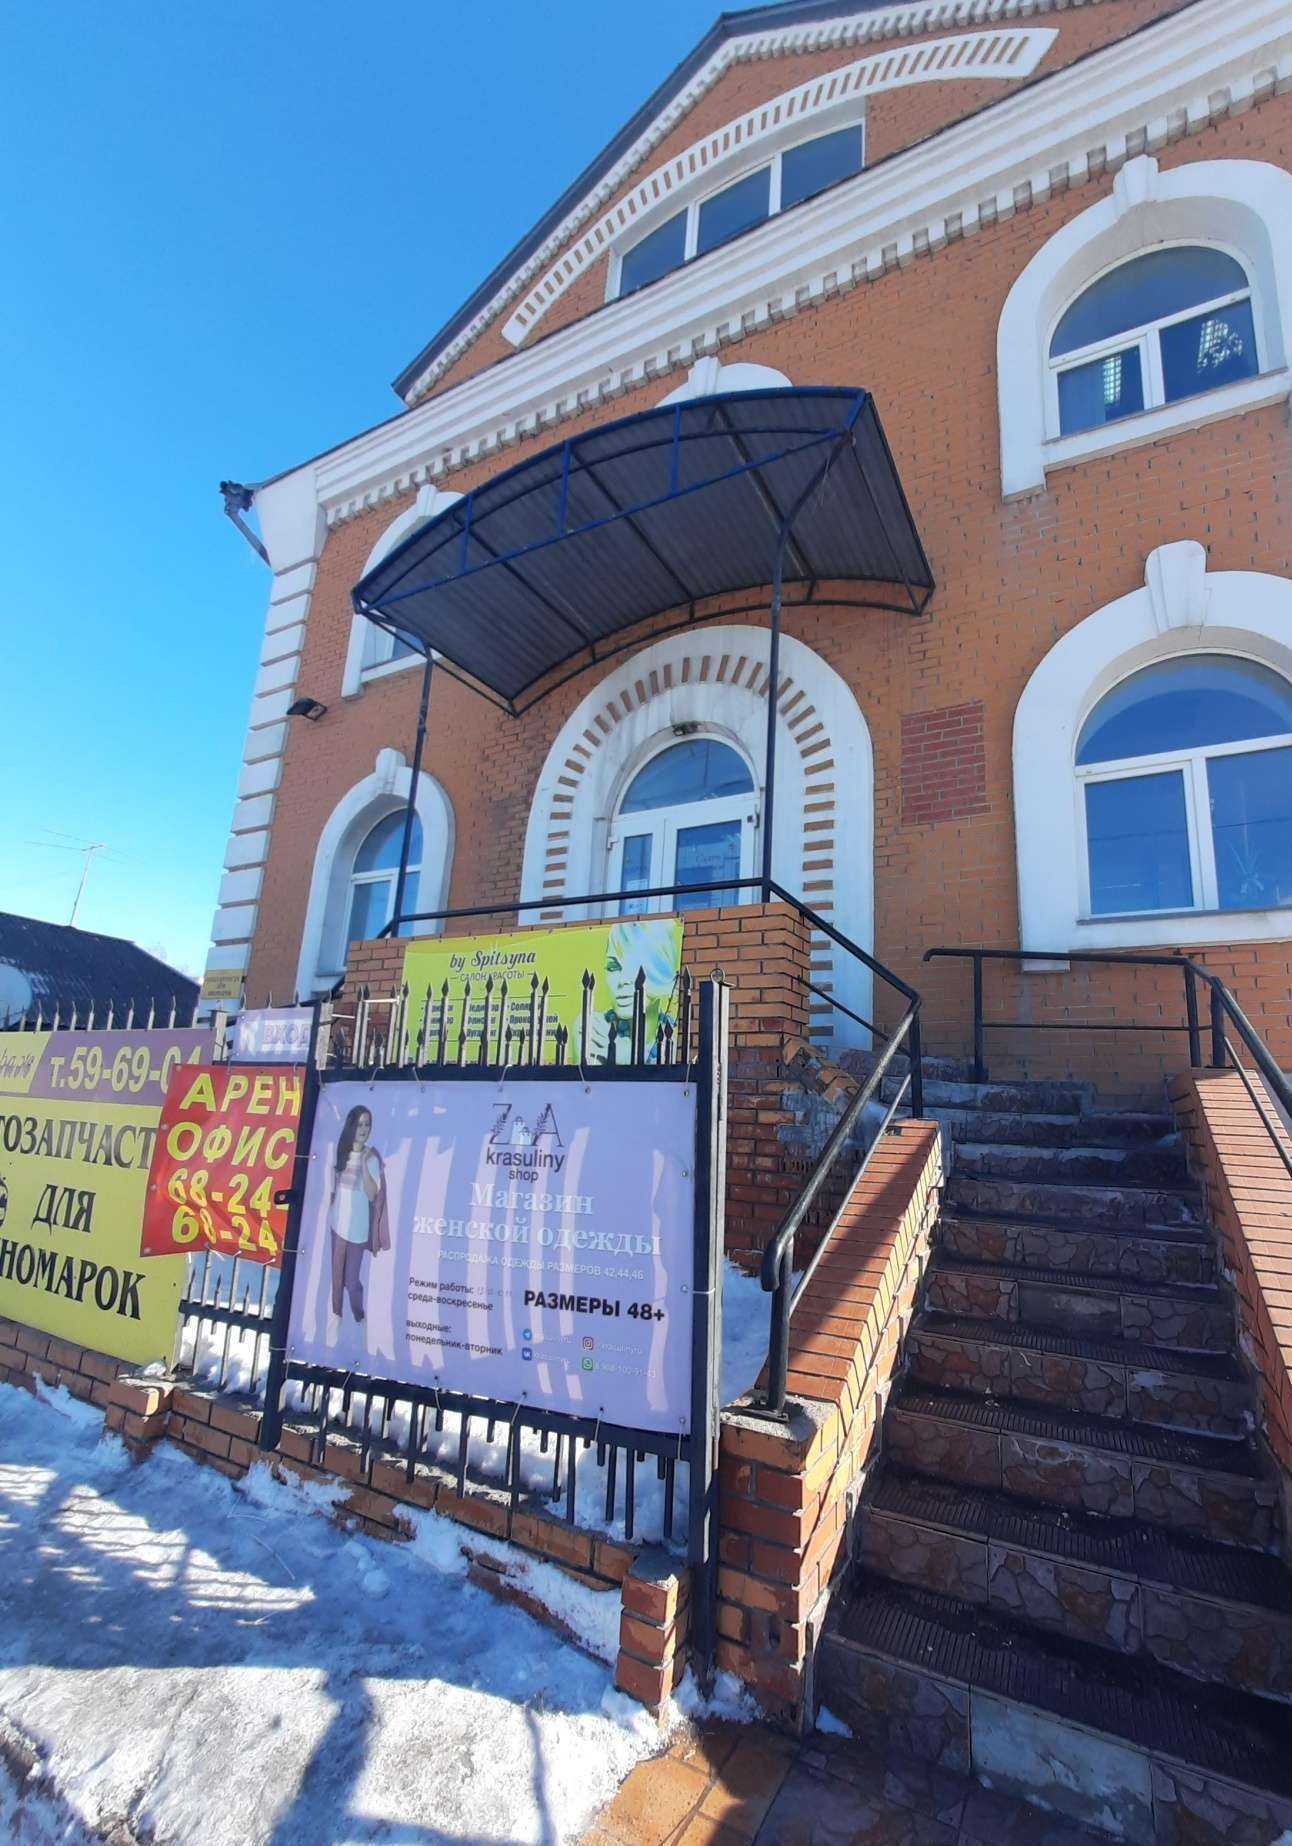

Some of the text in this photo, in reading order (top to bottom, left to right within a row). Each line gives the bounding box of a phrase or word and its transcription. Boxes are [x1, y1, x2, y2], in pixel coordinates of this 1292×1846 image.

[450, 950, 537, 972] by Spitsyna
[167, 1121, 295, 1170] ОФИС
[486, 1147, 565, 1174] krasuliny
[508, 1168, 539, 1184] shop
[31, 1183, 97, 1236] ДЛЯ
[468, 1182, 595, 1216] Магазин
[413, 1214, 662, 1257] женской одежды
[409, 1277, 437, 1289] Режим
[524, 1290, 621, 1317] РАЗМЕРЫ
[627, 1302, 665, 1322] 48+
